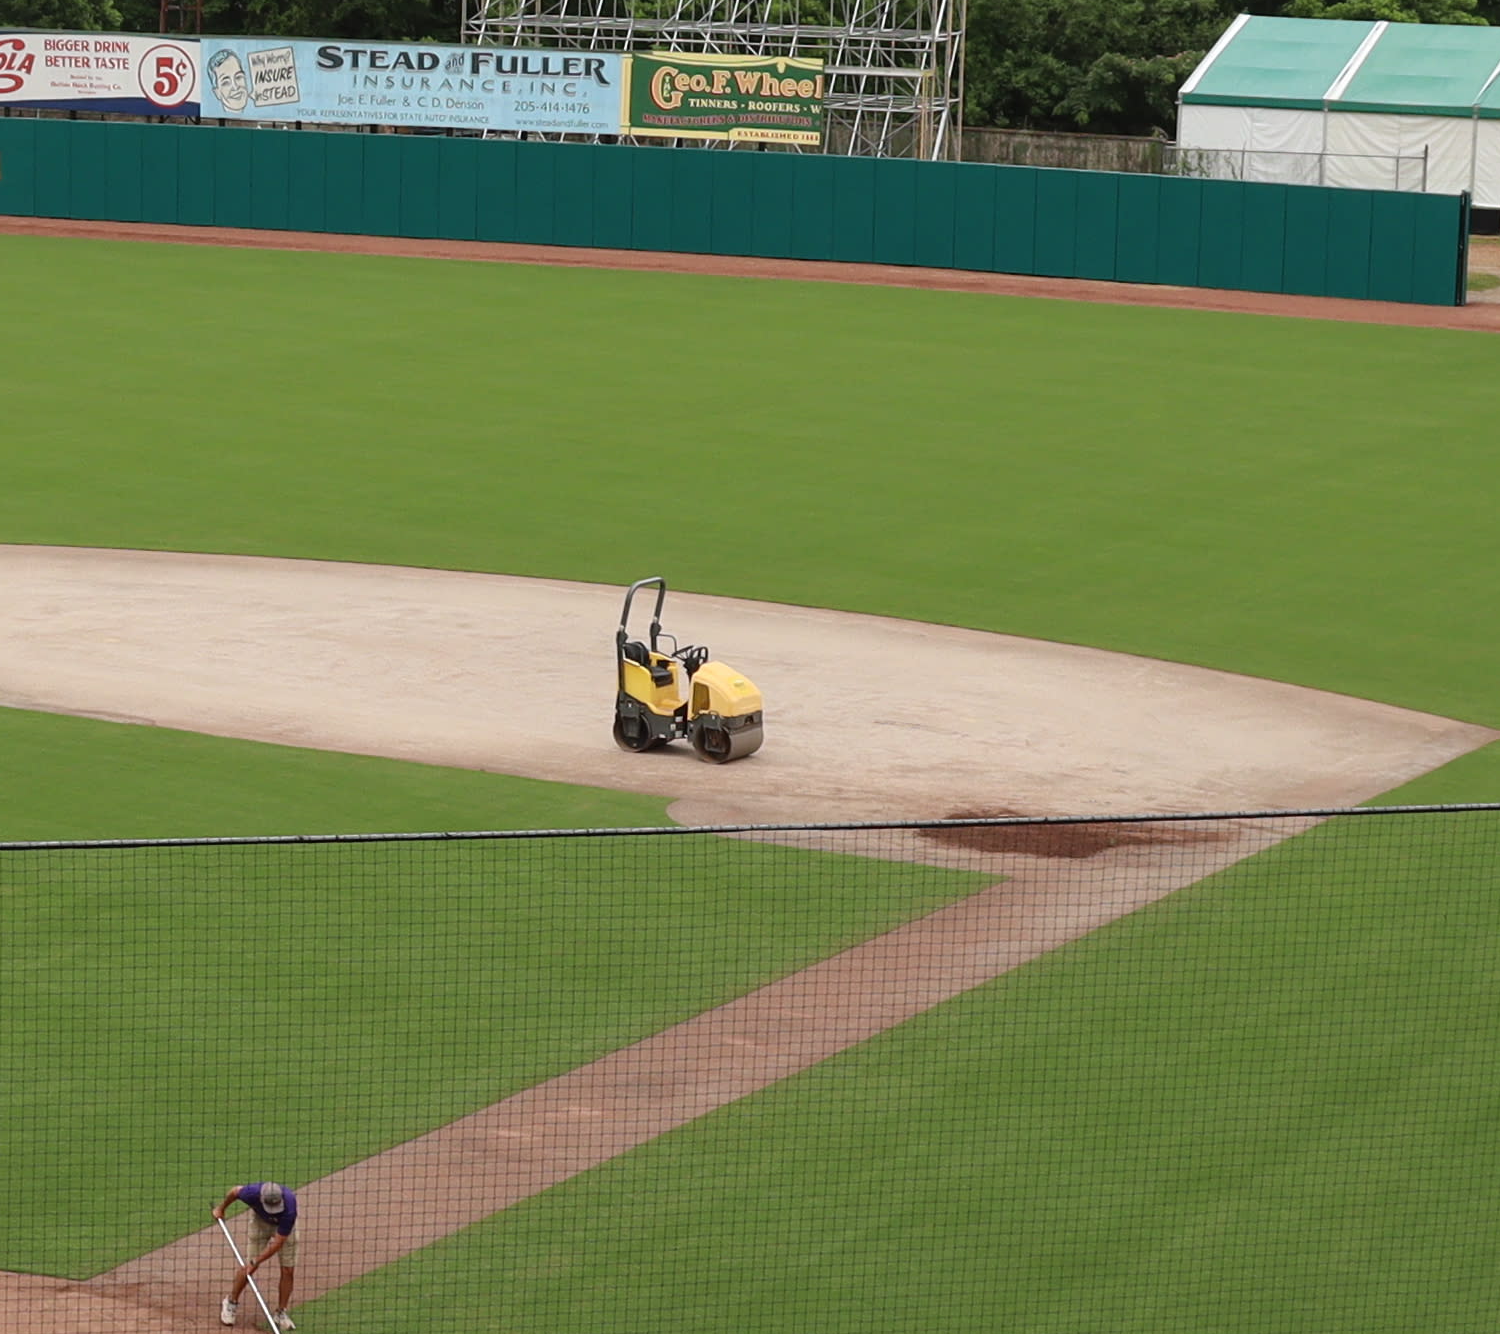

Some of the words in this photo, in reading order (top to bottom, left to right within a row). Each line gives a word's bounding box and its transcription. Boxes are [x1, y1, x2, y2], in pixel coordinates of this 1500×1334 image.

[44, 39, 90, 53] BIGGER
[94, 41, 130, 54] DRINK
[45, 55, 91, 69] BETTER
[94, 57, 130, 70] TASTE
[317, 45, 440, 72] STEAD
[445, 52, 465, 71] and
[471, 52, 611, 85] FULLER
[254, 67, 293, 84] INSURE
[370, 95, 396, 107] Fuller
[402, 96, 411, 108] &
[446, 98, 484, 111] Denson
[688, 98, 738, 109] TINNERS
[748, 101, 800, 113] ROOFERS
[399, 112, 422, 120] STATE
[737, 130, 799, 140] ESTABLISHED
